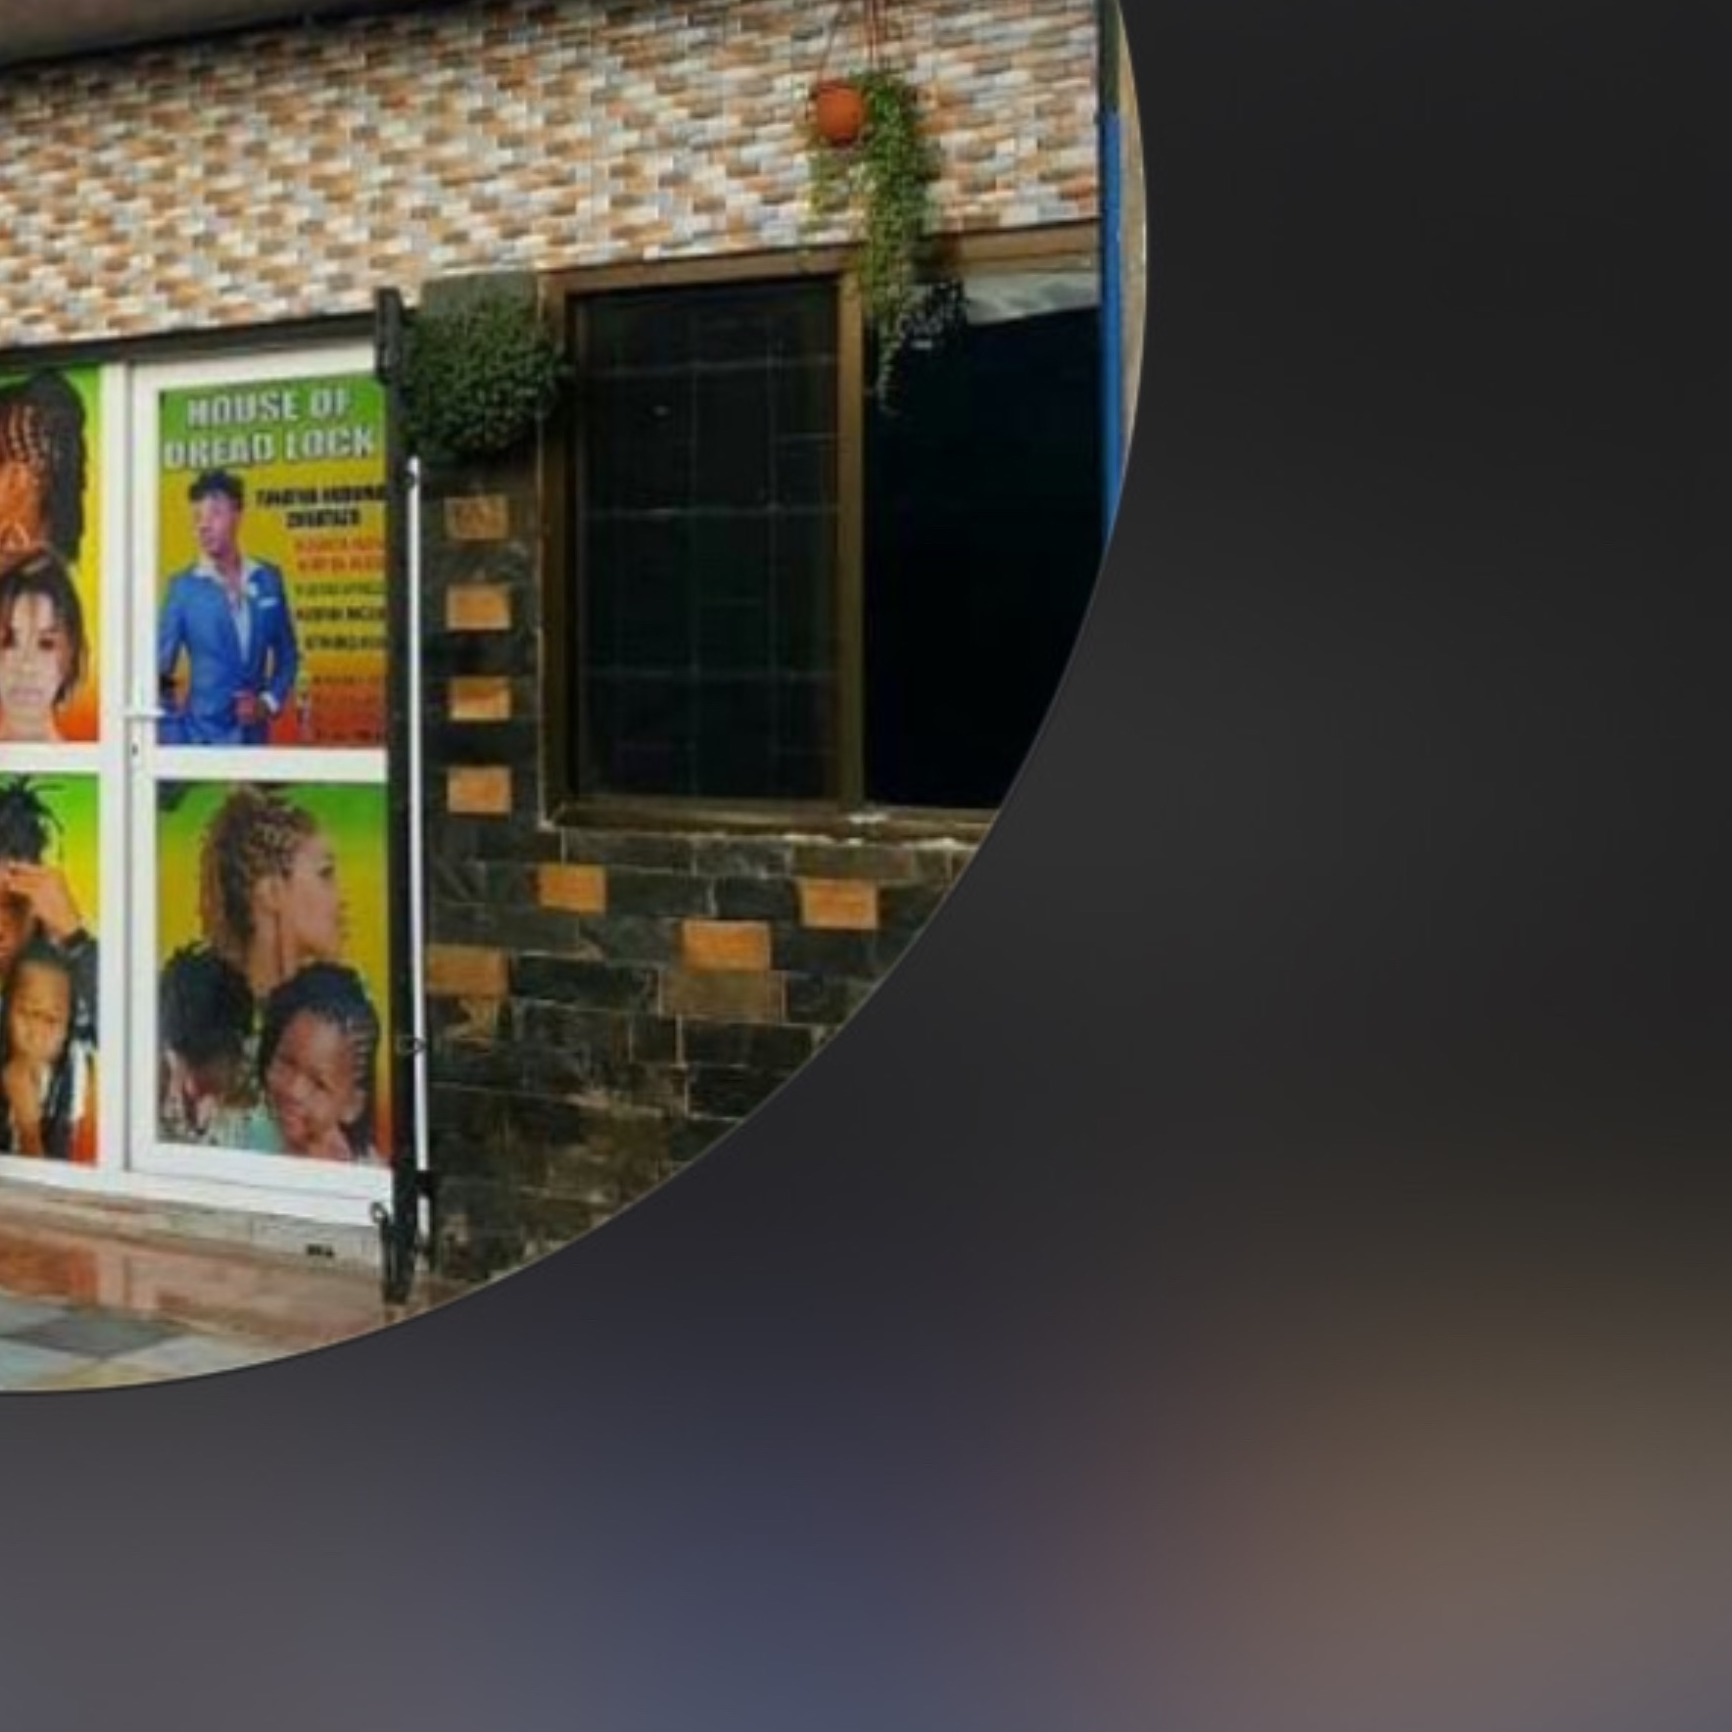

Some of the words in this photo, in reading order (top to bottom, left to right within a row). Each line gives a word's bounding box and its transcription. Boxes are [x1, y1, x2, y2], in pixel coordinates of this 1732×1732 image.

[186, 389, 300, 428] HOUSE
[310, 385, 351, 418] OF
[164, 430, 274, 469] DREAD
[285, 424, 374, 461] LOCK
